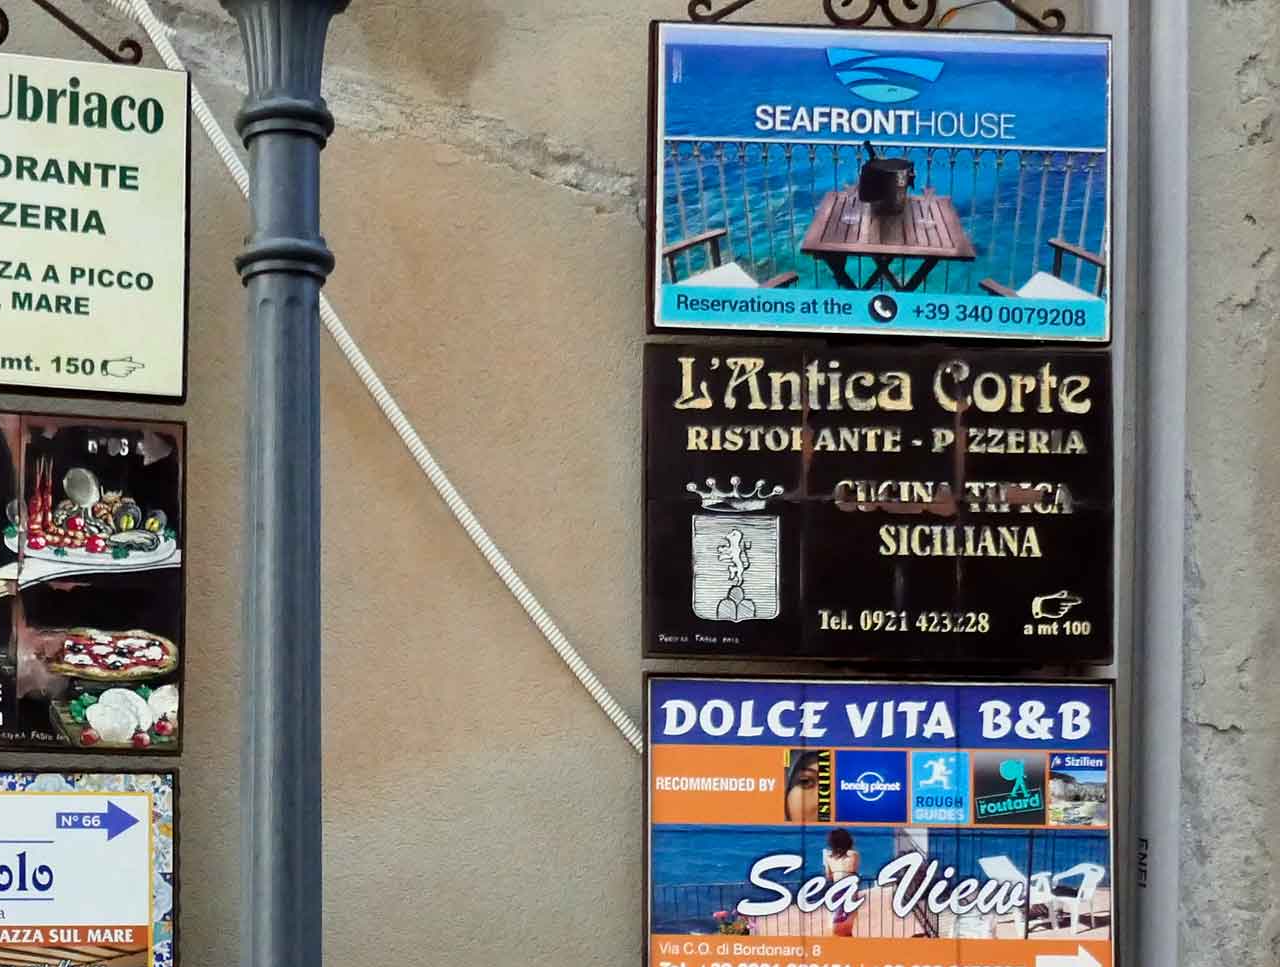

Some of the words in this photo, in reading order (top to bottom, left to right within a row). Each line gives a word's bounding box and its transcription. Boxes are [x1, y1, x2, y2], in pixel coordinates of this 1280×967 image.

[755, 105, 1016, 139] SEAFRONTHOUSE
[41, 264, 60, 283] A
[70, 267, 154, 290] PICCO
[12, 292, 90, 315] MARE
[676, 294, 795, 314] Reservations
[800, 298, 818, 313] at
[824, 299, 852, 316] the
[912, 305, 950, 321] +39
[955, 306, 992, 322] 340
[999, 307, 1086, 326] 0079208
[1, 353, 40, 372] mt.
[51, 356, 95, 376] 150
[933, 361, 1092, 414] Corte
[932, 429, 1087, 455] PZZERIA
[834, 479, 958, 514] CUCIN
[879, 525, 1042, 557] SICILIANA
[818, 608, 853, 631] Tel.
[860, 610, 908, 632] 0921
[1023, 622, 1033, 635] a
[1037, 621, 1059, 635] mt
[1063, 621, 1091, 635] 100
[660, 699, 828, 738] DOLCE
[846, 703, 956, 740] VITA
[978, 700, 1091, 740] B&B
[1064, 756, 1103, 768] Sizilien
[655, 777, 755, 791] RECOMMENDED
[759, 779, 776, 791] BY
[840, 779, 872, 794] lonely
[874, 780, 900, 794] planet
[916, 796, 964, 808] ROUGH
[979, 793, 1041, 814] routard
[60, 815, 79, 827] N°
[82, 815, 101, 827] 66
[736, 854, 866, 918] Sea
[877, 851, 1025, 917] View
[49, 928, 82, 943] SUL
[86, 928, 133, 943] MARE
[660, 943, 679, 956] Via
[716, 943, 729, 957] di
[812, 944, 821, 957] 8
